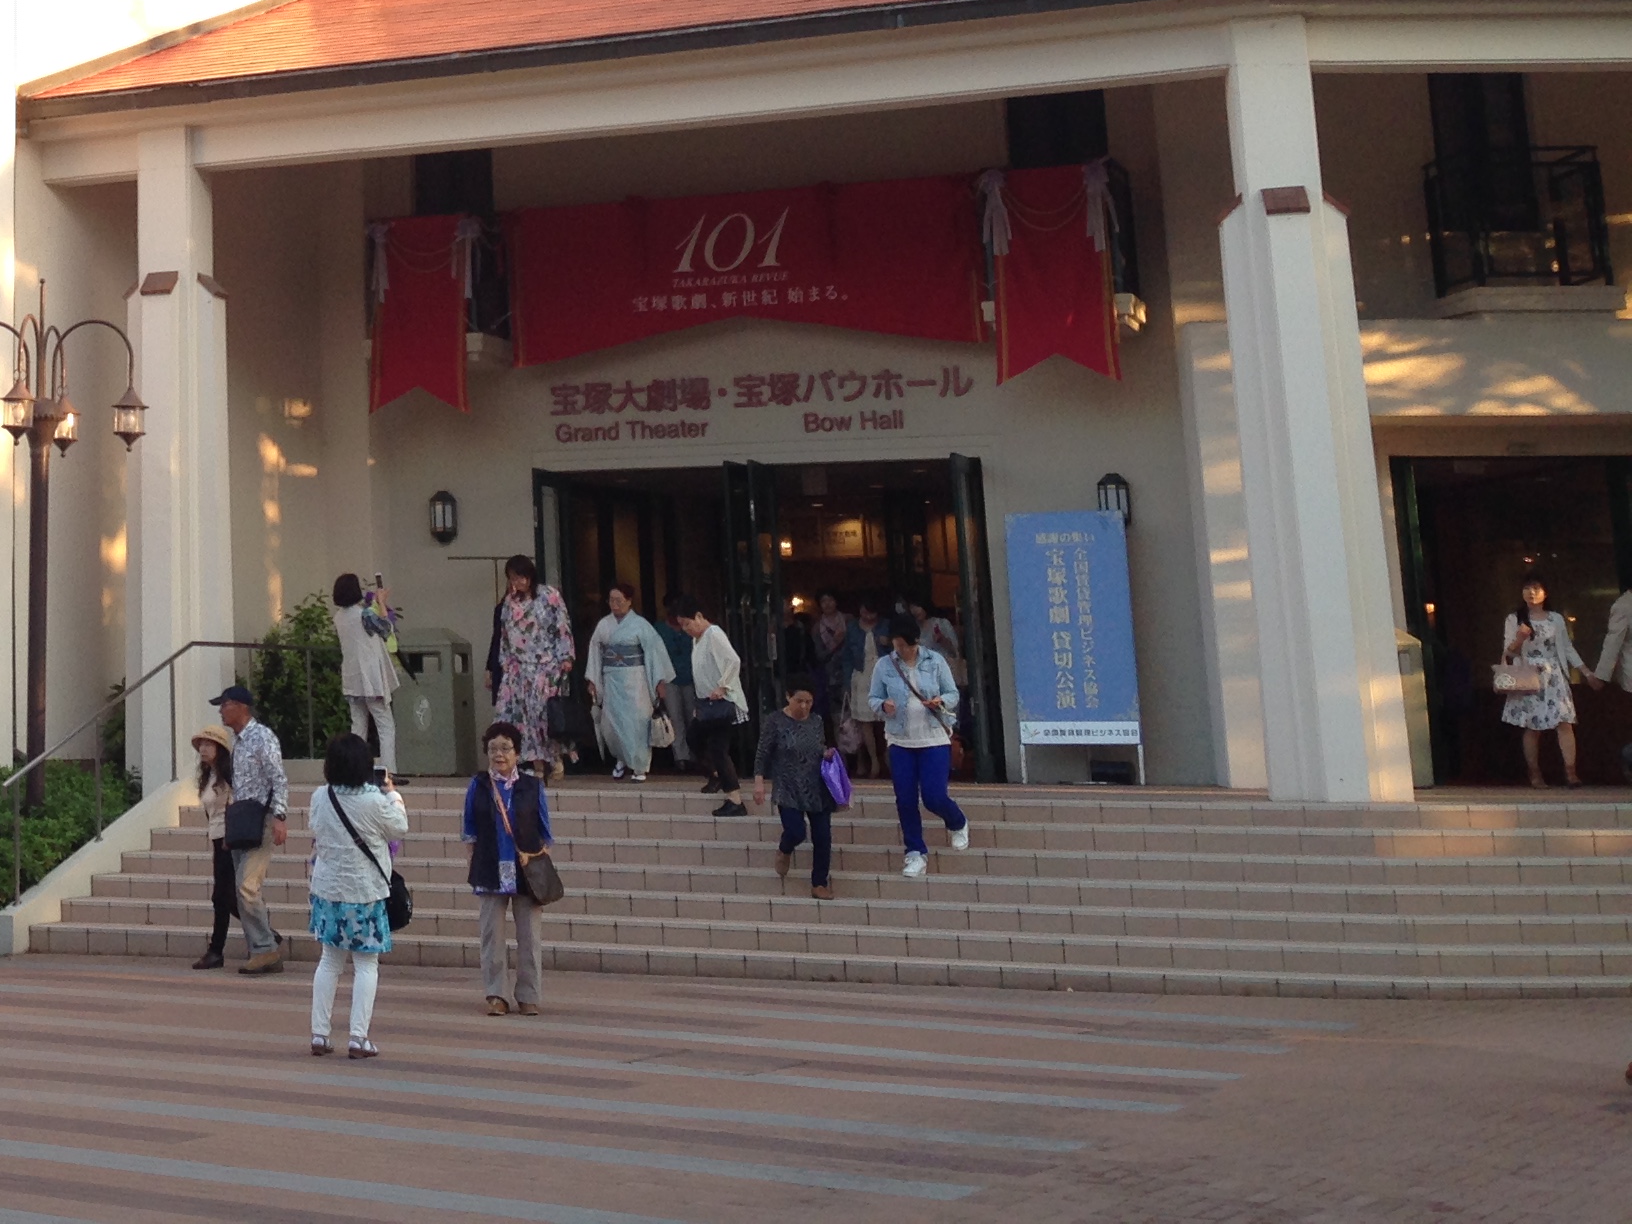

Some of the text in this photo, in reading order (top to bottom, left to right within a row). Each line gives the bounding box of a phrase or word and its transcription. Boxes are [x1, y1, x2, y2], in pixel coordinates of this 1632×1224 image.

[673, 206, 790, 274] 101
[673, 271, 790, 288] TAKARAZUKA REVUE
[555, 409, 905, 443] Grand Theater Bow Hall
